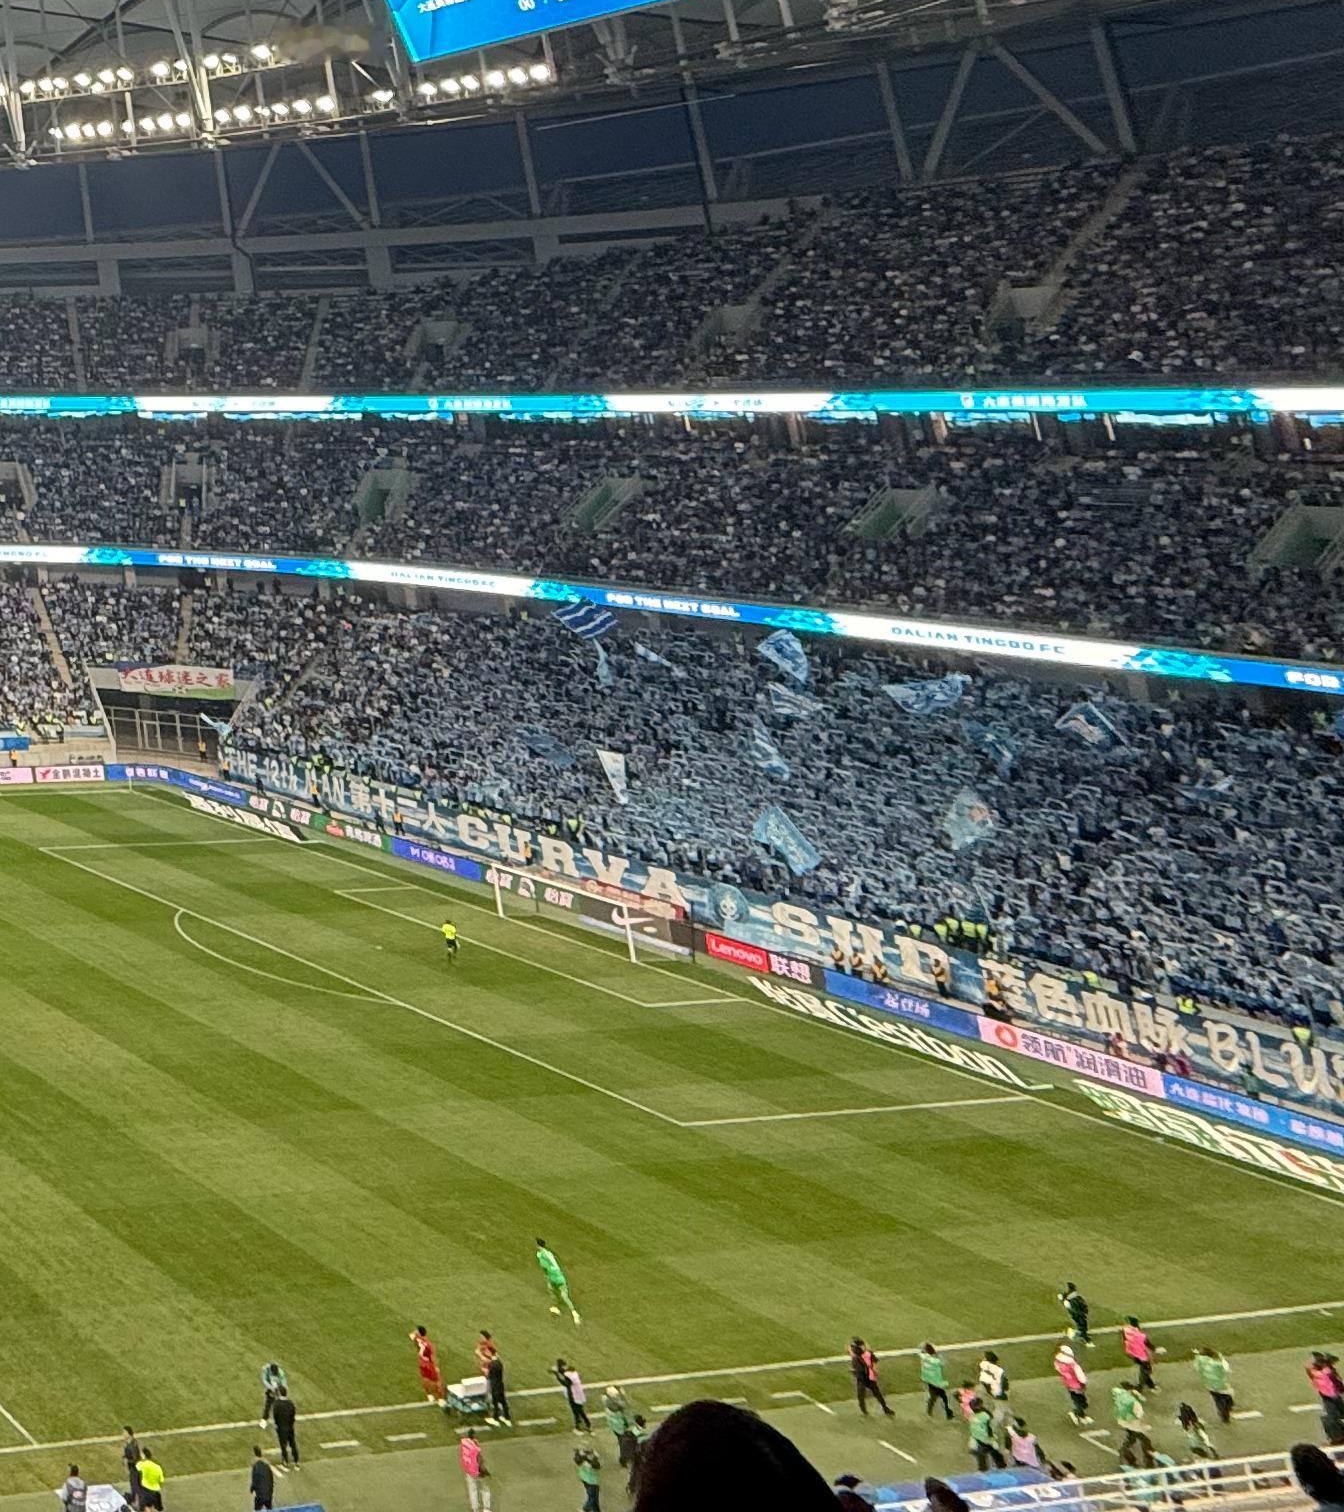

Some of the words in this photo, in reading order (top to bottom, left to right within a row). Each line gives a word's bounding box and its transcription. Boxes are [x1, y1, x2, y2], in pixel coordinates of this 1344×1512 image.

[891, 627, 958, 642] DALIAN
[1039, 644, 1065, 654] FC
[1285, 670, 1340, 688] FOR
[456, 814, 691, 912] CURVA
[711, 939, 763, 966] Lenovo
[769, 953, 812, 984] 联想
